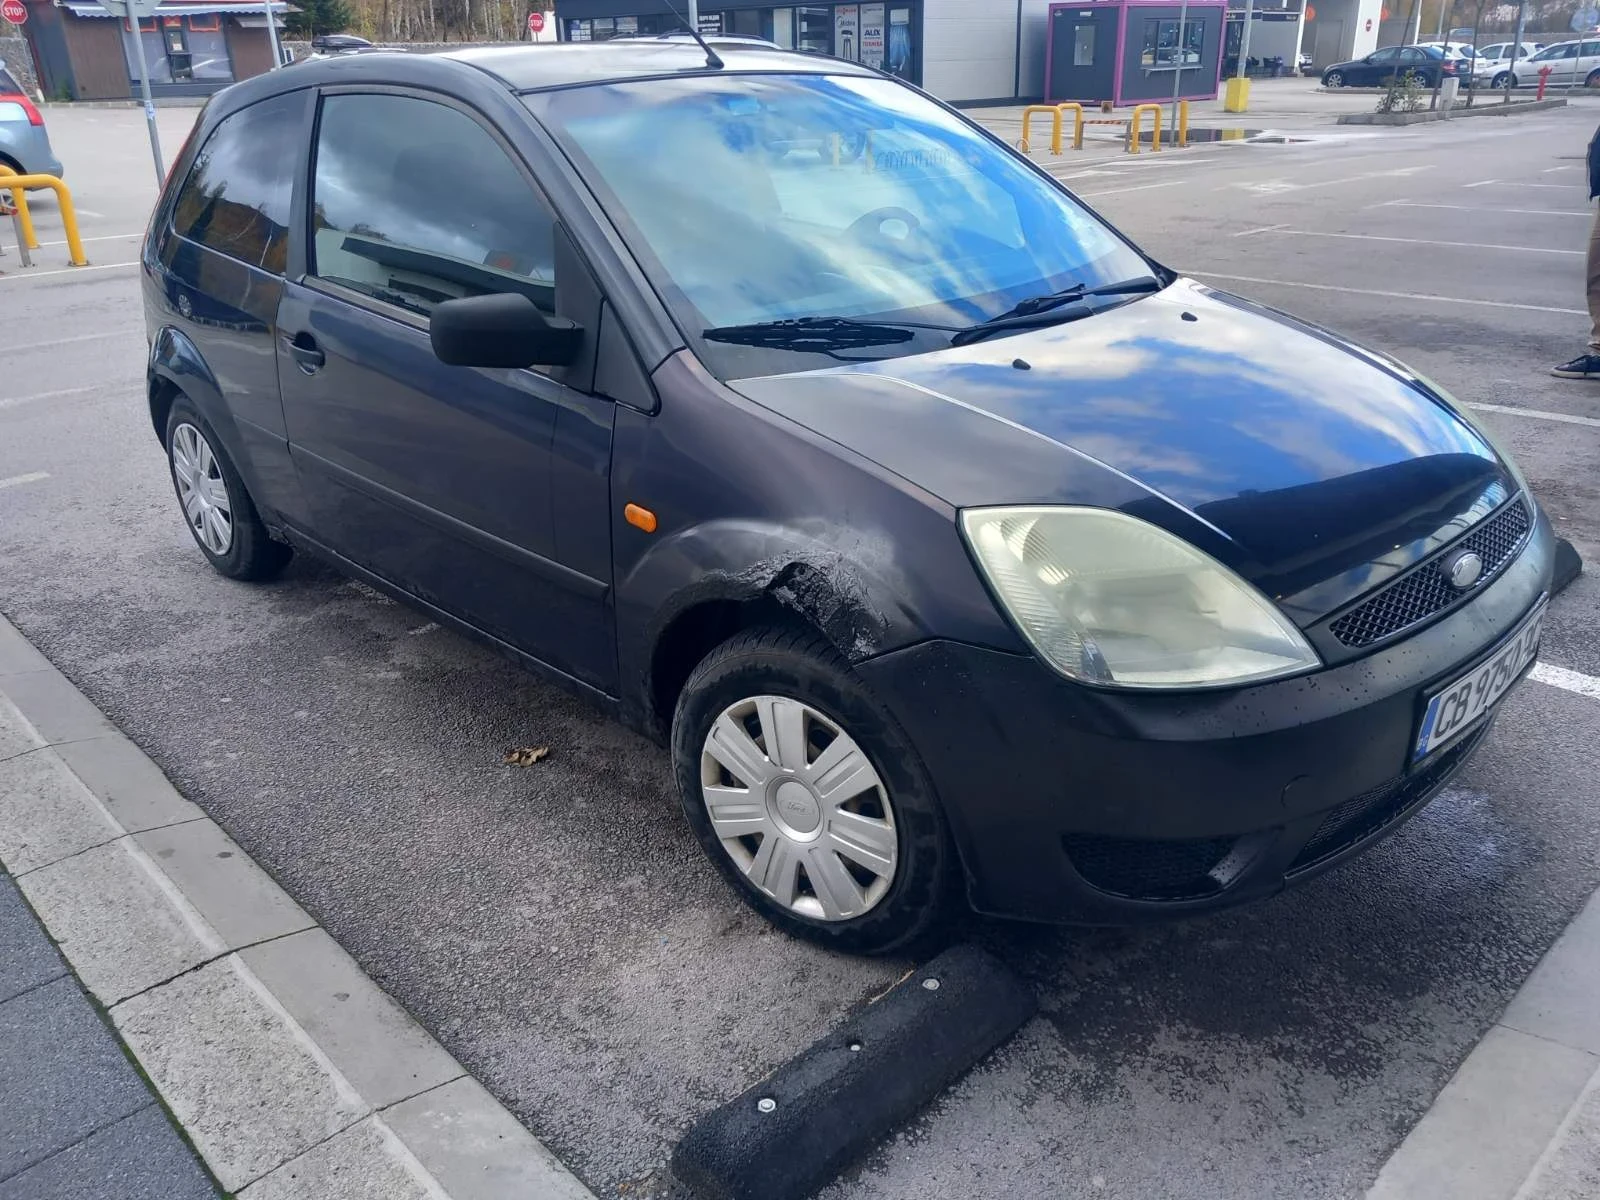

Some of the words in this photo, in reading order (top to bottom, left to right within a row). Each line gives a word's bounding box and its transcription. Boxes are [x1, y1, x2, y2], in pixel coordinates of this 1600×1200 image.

[4, 6, 24, 17] STOP
[530, 19, 543, 27] STOP
[1434, 681, 1473, 739] CB
